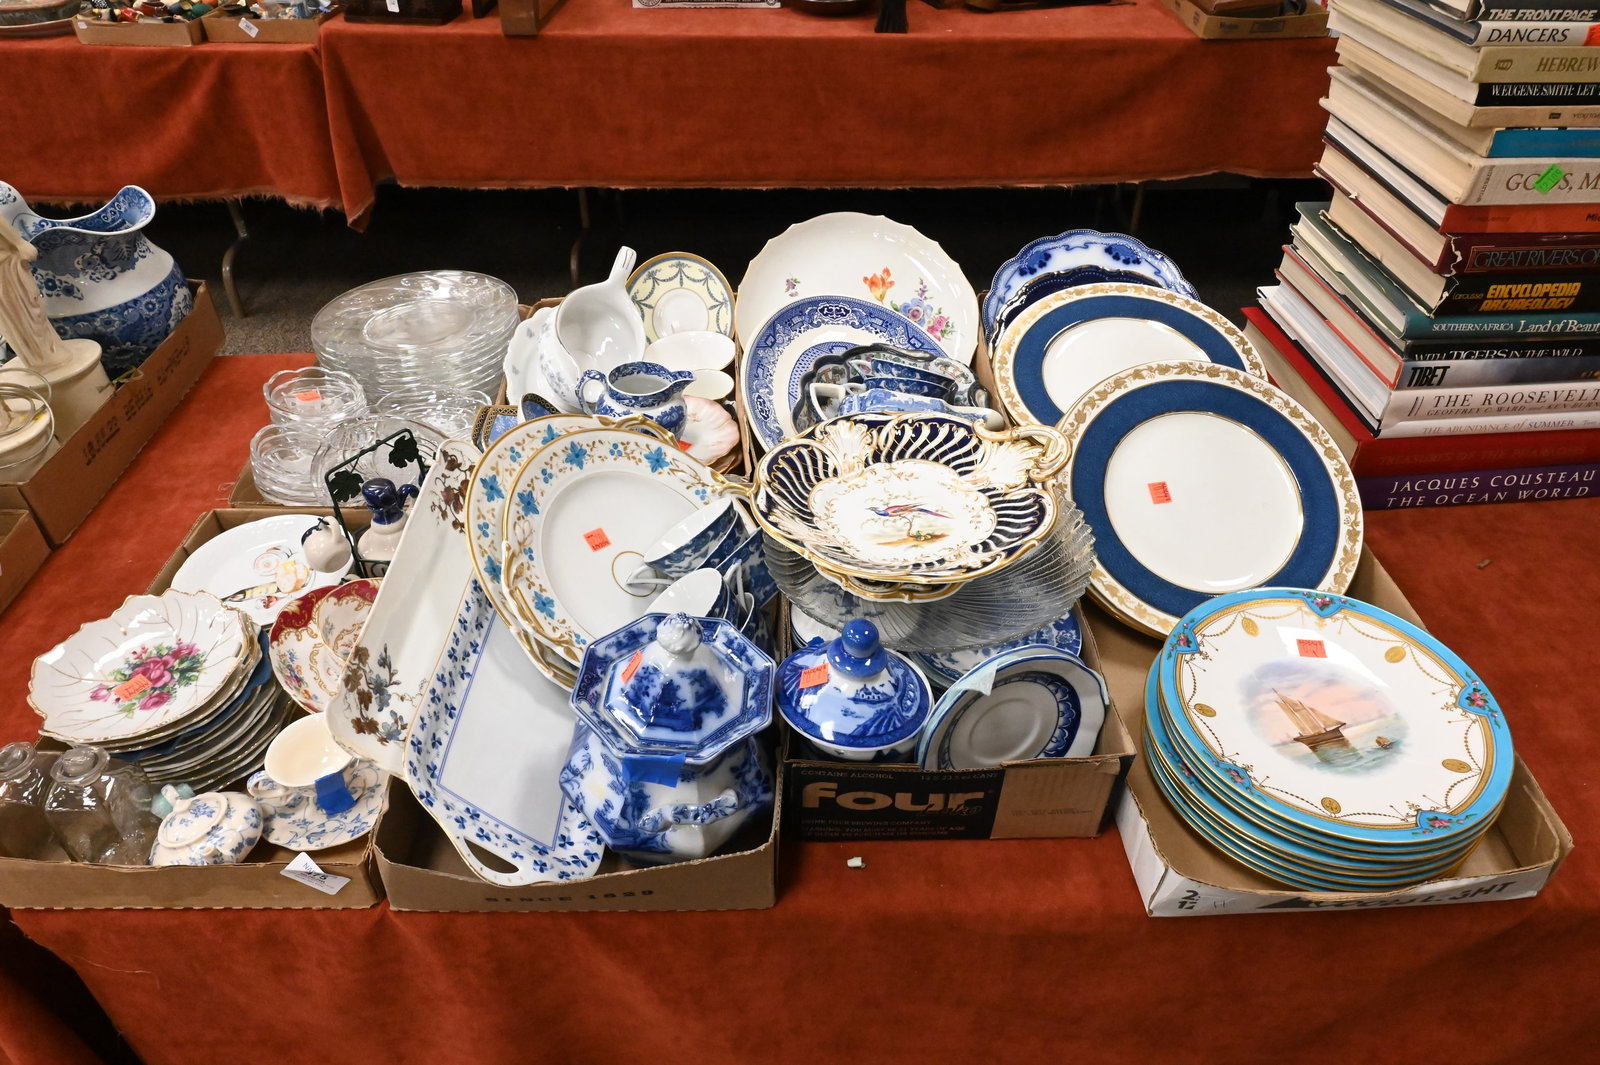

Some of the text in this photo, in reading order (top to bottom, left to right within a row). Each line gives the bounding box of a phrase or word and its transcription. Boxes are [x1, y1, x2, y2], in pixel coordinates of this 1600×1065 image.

[1488, 8, 1598, 20] THE FRONT PAGE
[1486, 28, 1570, 42] DANCERS
[1536, 57, 1600, 72] HEBREW
[1501, 85, 1540, 97] EUGENE
[1541, 84, 1575, 96] SMITH:
[1576, 84, 1597, 96] LET
[1505, 172, 1574, 193] GOS,
[1474, 250, 1526, 268] GREAT
[1525, 249, 1579, 267] RIVERS
[1486, 282, 1582, 299] ENCYCLOPEDIA
[1478, 297, 1576, 312] ARCHAEOLOGY
[1431, 323, 1482, 332] SOUTHERN
[1480, 322, 1514, 331] AFRICA
[1517, 320, 1550, 333] Land
[1550, 320, 1566, 333] of
[1414, 348, 1583, 361] WITH TIGERS IN THE WILD
[1407, 365, 1451, 388] TIBET
[1433, 393, 1474, 408] THE
[1426, 407, 1481, 417] GEOFFREY
[1496, 405, 1526, 414] WARD
[1547, 402, 1569, 410] KEN
[1423, 426, 1443, 435] THE
[1446, 423, 1510, 433] ABUNDANCE
[1512, 419, 1526, 431] of
[1527, 419, 1576, 429] SUMMER
[1390, 470, 1597, 494] JACQUES COUSTEAU
[1385, 486, 1591, 508] THE OCEAN WORLD
[850, 771, 894, 779] ALCOHOL
[803, 781, 985, 812] four
